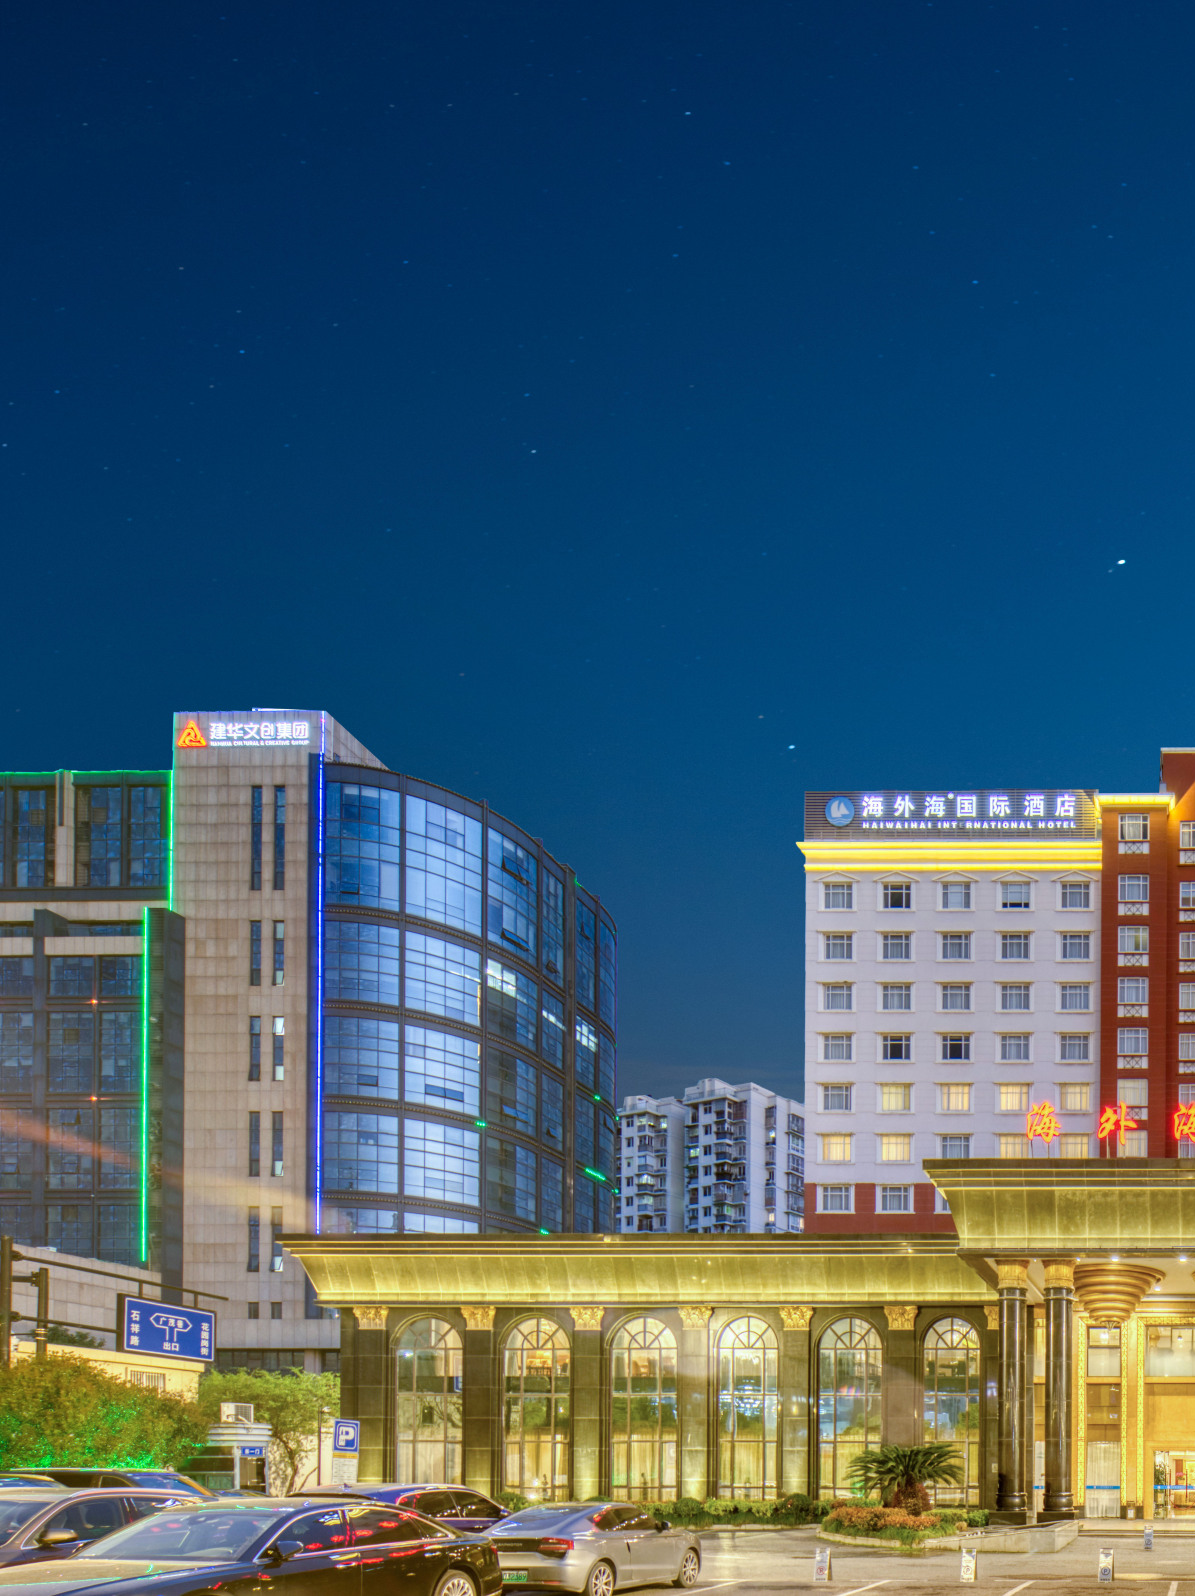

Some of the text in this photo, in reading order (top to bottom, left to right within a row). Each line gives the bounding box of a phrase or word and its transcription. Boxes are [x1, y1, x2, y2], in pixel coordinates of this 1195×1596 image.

[209, 722, 310, 740] 建华文创集团
[862, 795, 1076, 818] 海外海国际酒店
[862, 820, 1076, 829] HAIWAIHAI INTERNATIONAL HOTEL
[130, 1310, 140, 1346] 石祥路
[163, 1342, 180, 1352] 出口
